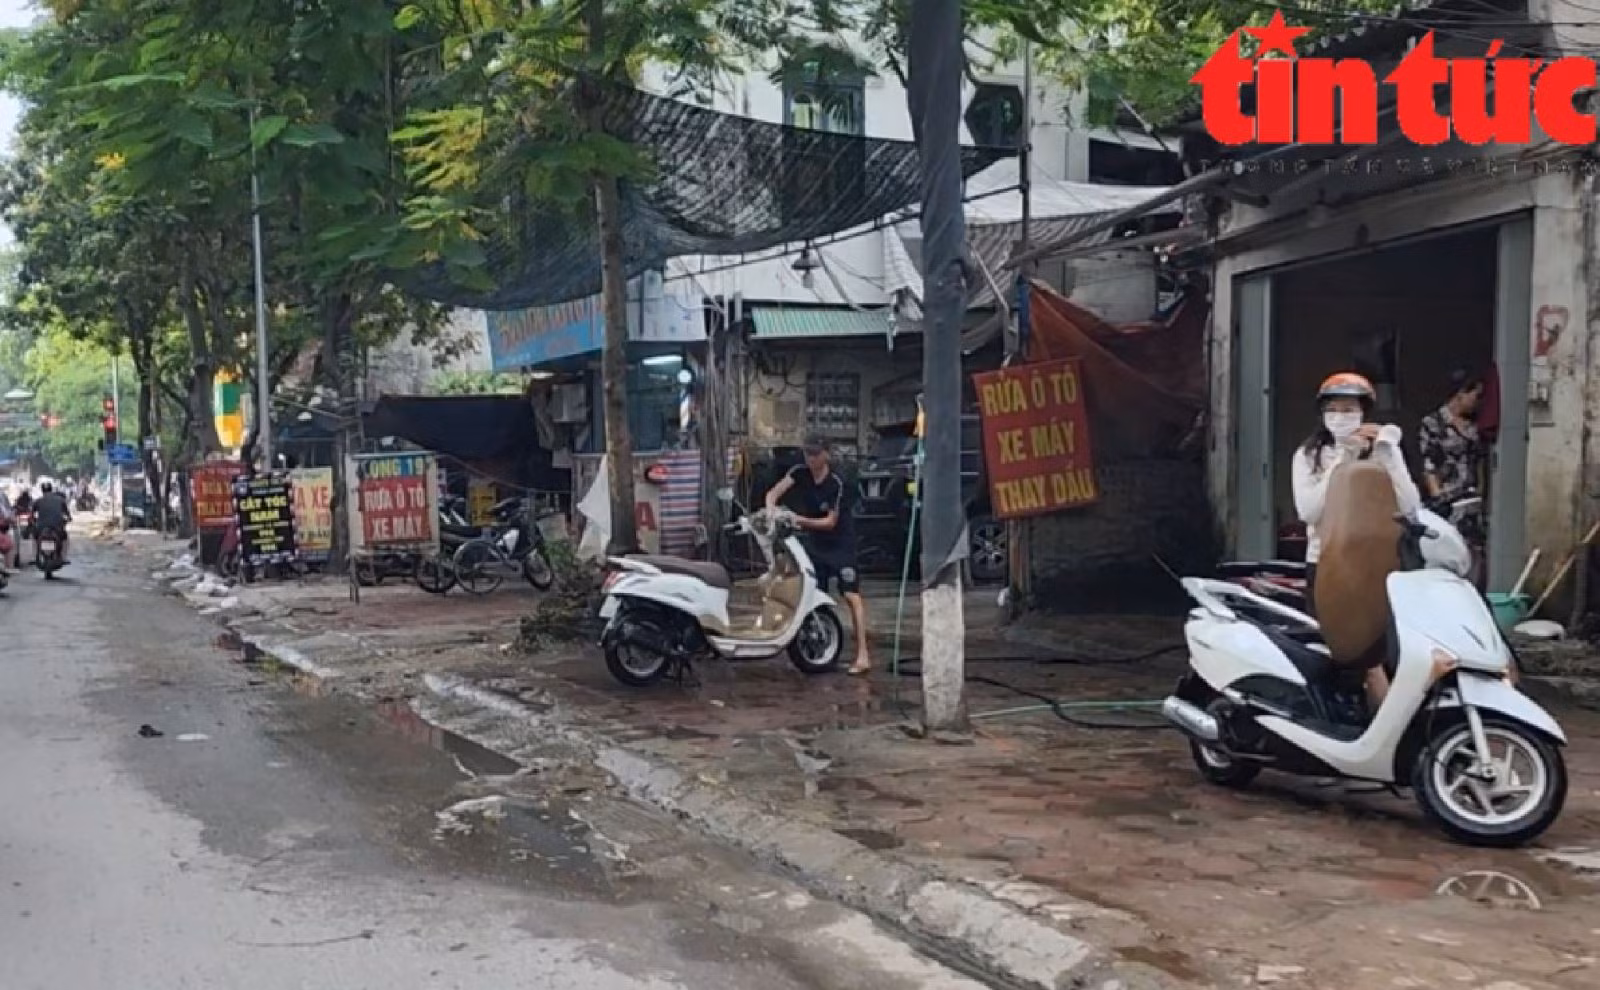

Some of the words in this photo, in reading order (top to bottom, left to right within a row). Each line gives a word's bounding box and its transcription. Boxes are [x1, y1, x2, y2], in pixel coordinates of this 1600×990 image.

[982, 370, 1027, 417] RỬA
[1031, 369, 1046, 409] Ô
[1051, 365, 1077, 405] TÔ
[997, 430, 1027, 464] XE
[1030, 416, 1075, 458] MÁY
[311, 486, 329, 509] XE
[995, 474, 1047, 512] THAY
[372, 517, 389, 540] XE
[393, 511, 422, 538] MÁY
